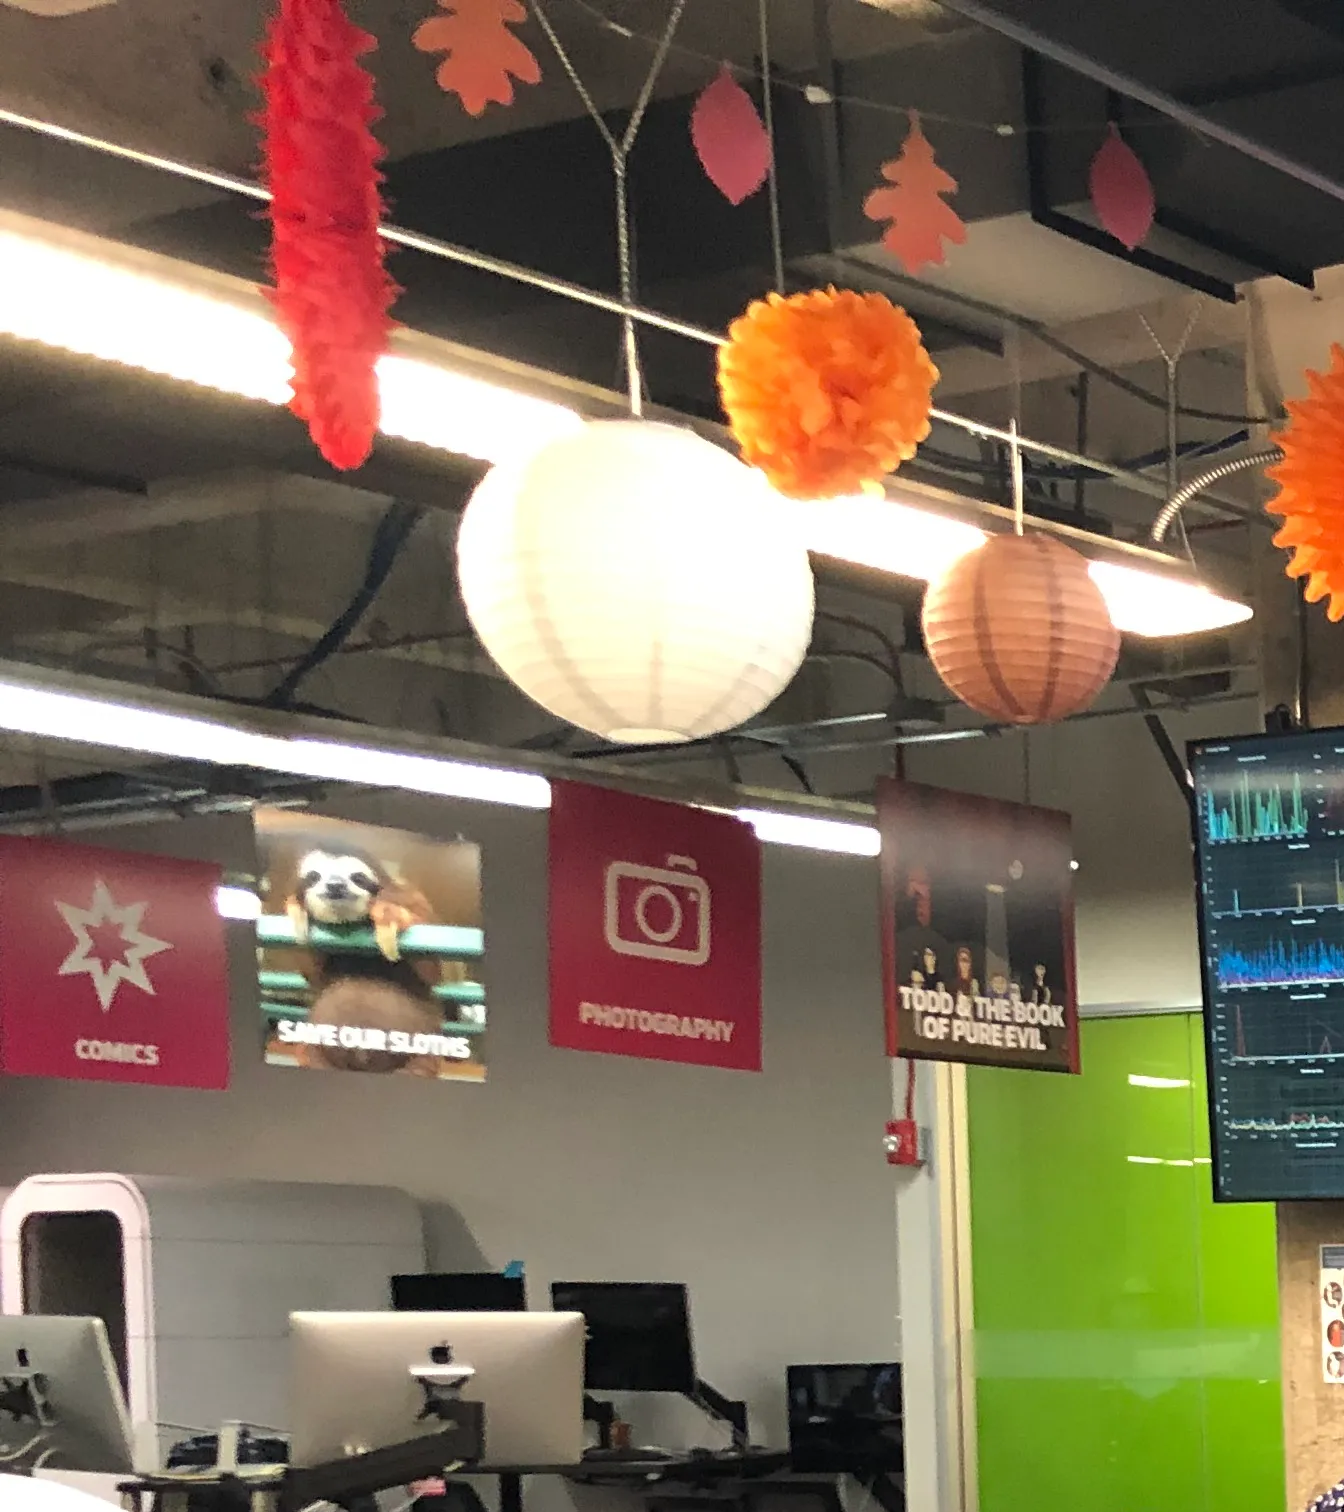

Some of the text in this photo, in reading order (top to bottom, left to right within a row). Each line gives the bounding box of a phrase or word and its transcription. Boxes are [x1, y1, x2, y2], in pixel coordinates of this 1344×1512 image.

[579, 1001, 735, 1042] PHOTOGRAPHY
[899, 986, 1066, 1027] TODD & THE BOOK
[74, 1039, 160, 1066] COMICS
[277, 1019, 471, 1059] SAVE OUR SLOTHS
[922, 1016, 1047, 1050] OF PURE EVIL
